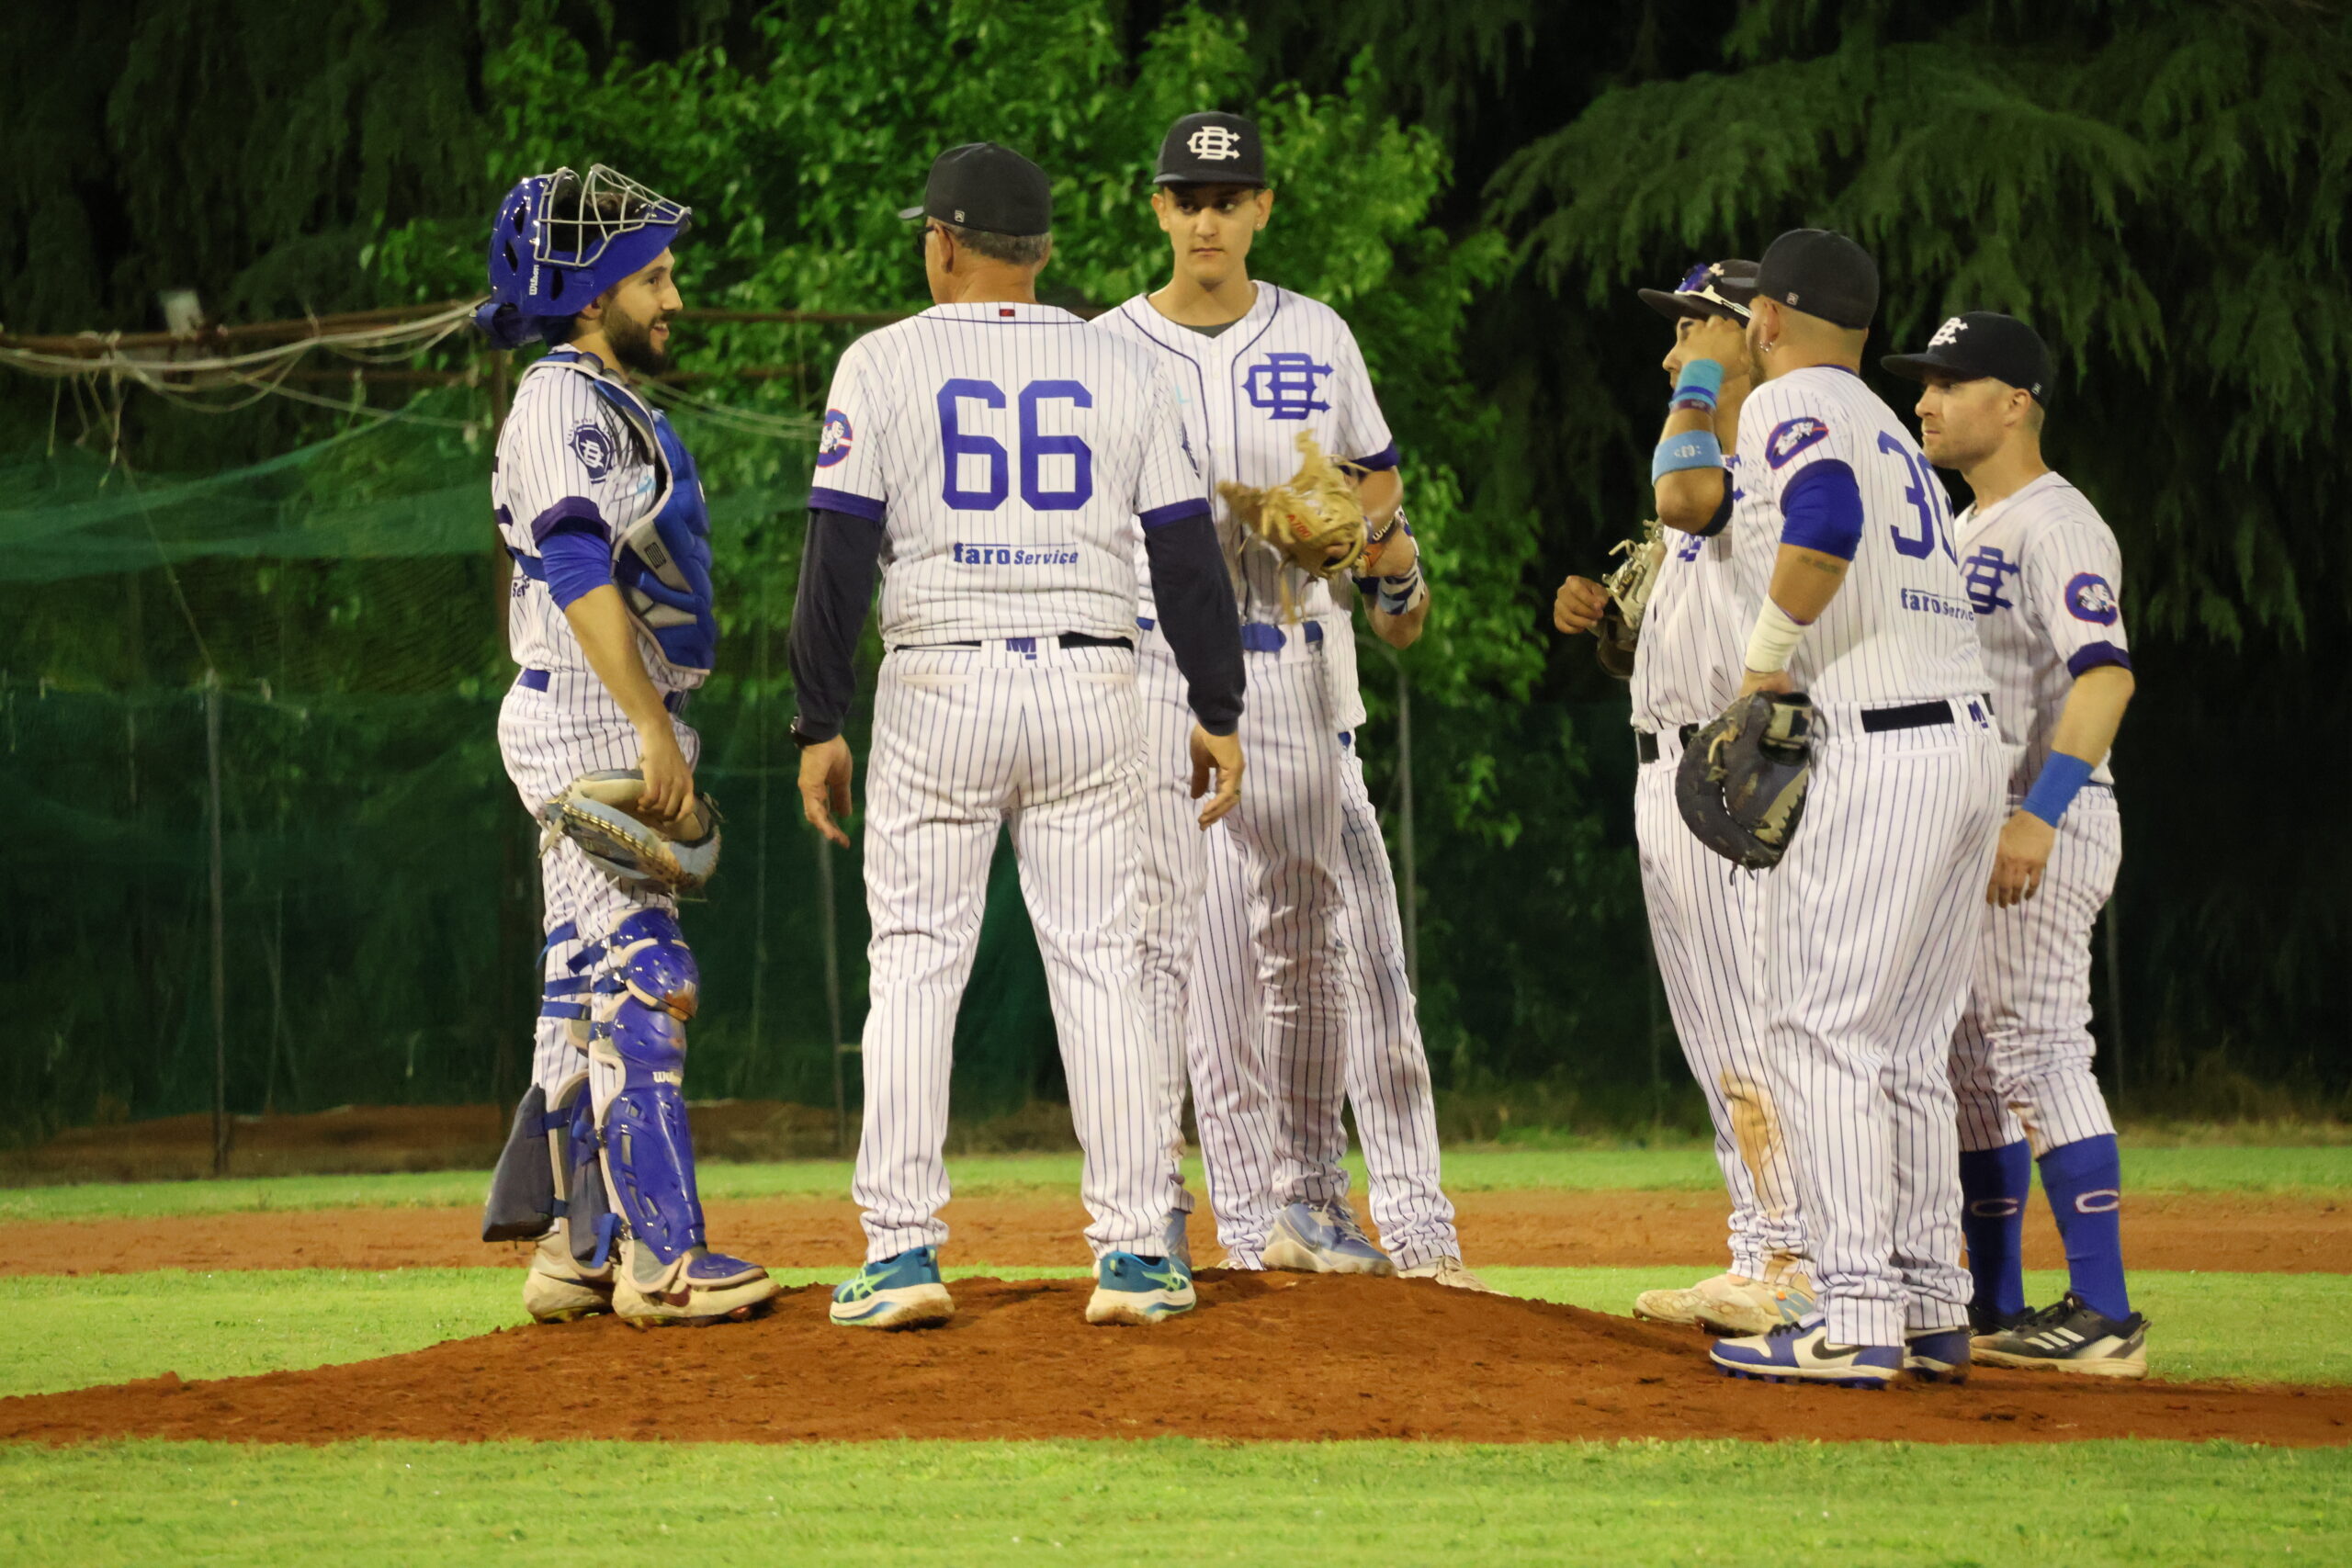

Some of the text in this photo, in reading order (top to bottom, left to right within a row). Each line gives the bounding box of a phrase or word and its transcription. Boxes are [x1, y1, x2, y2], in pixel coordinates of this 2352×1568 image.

[528, 264, 540, 296] Wilson
[936, 378, 1093, 512] 66
[953, 542, 1079, 565] faro Service
[1900, 587, 1941, 614] faro
